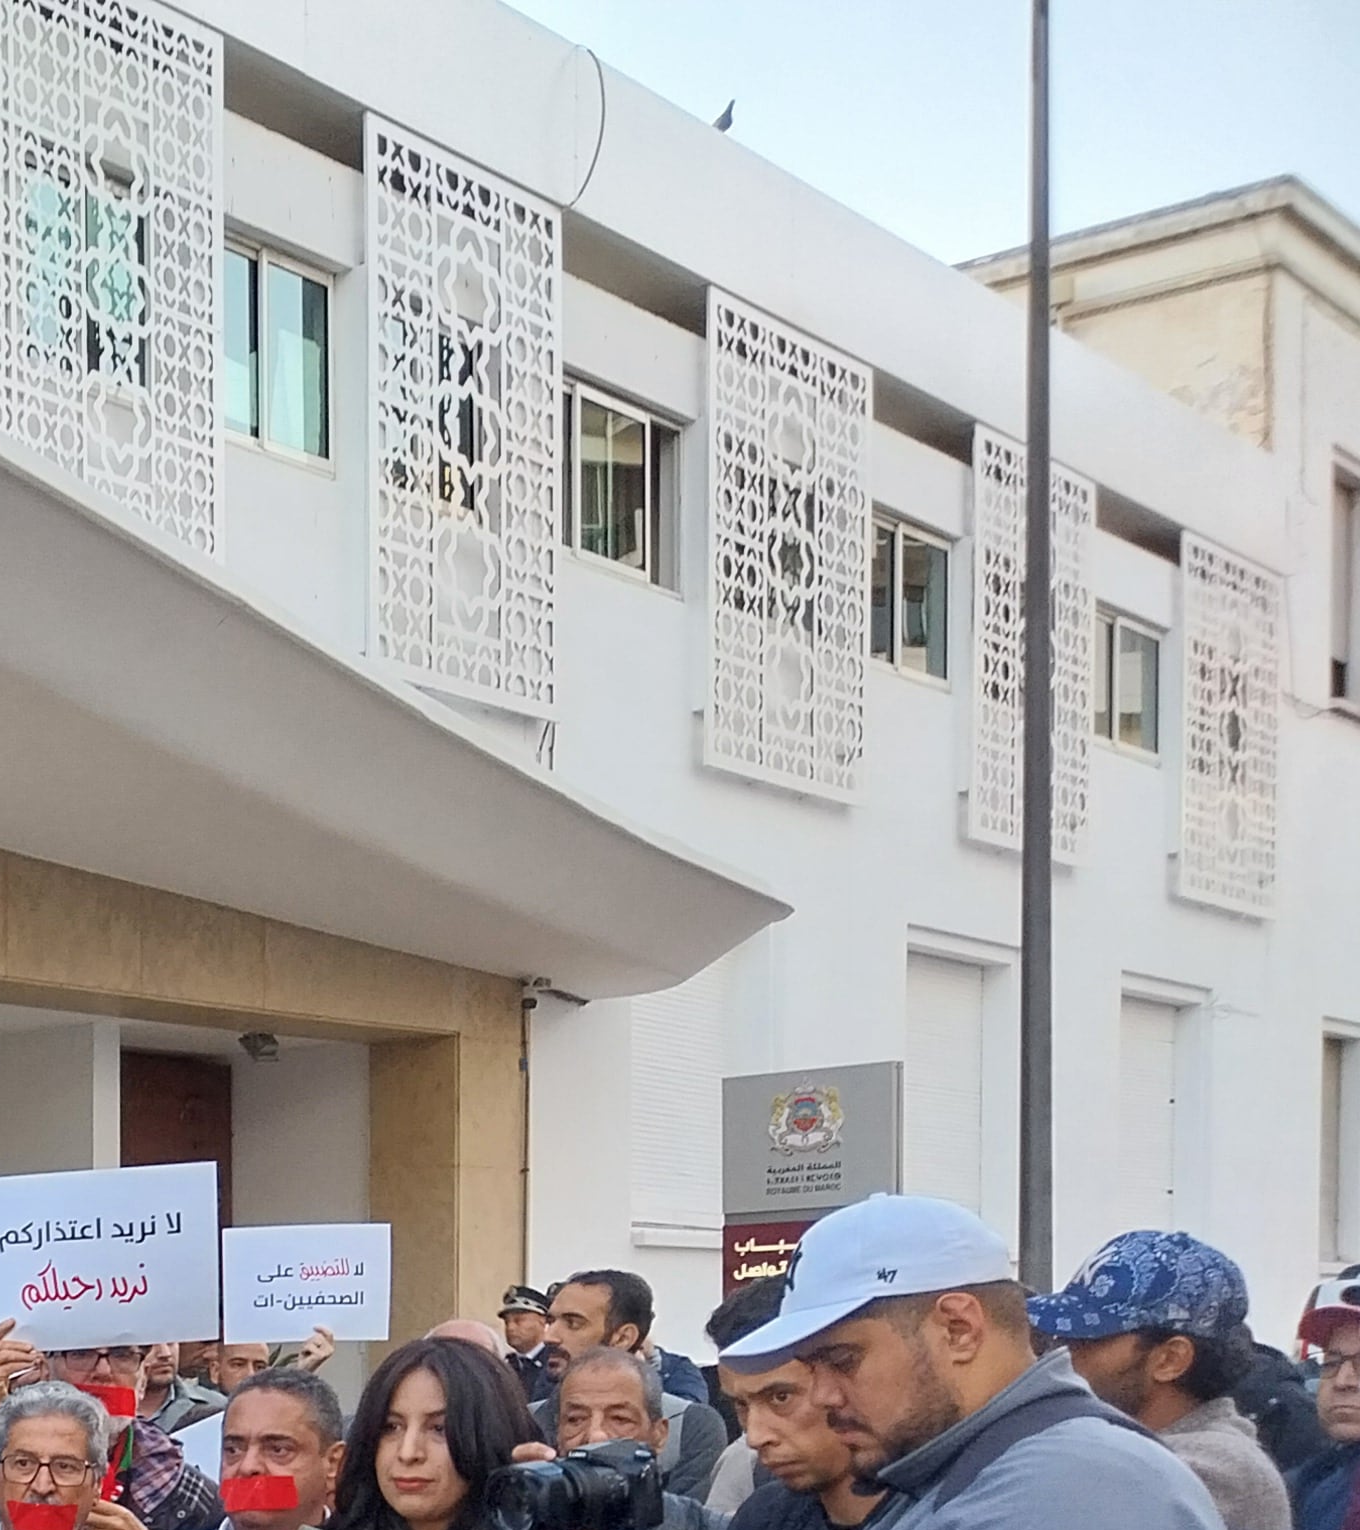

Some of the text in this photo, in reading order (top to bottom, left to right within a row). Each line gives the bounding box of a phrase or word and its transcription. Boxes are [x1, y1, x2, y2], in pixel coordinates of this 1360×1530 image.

[111, 1214, 157, 1244] نريد
[166, 1211, 182, 1235] لا
[257, 1258, 365, 1283] لا للتضييق على
[21, 1260, 149, 1311] نريد رحيلكم
[253, 1291, 365, 1311] الصحفيين-ات
